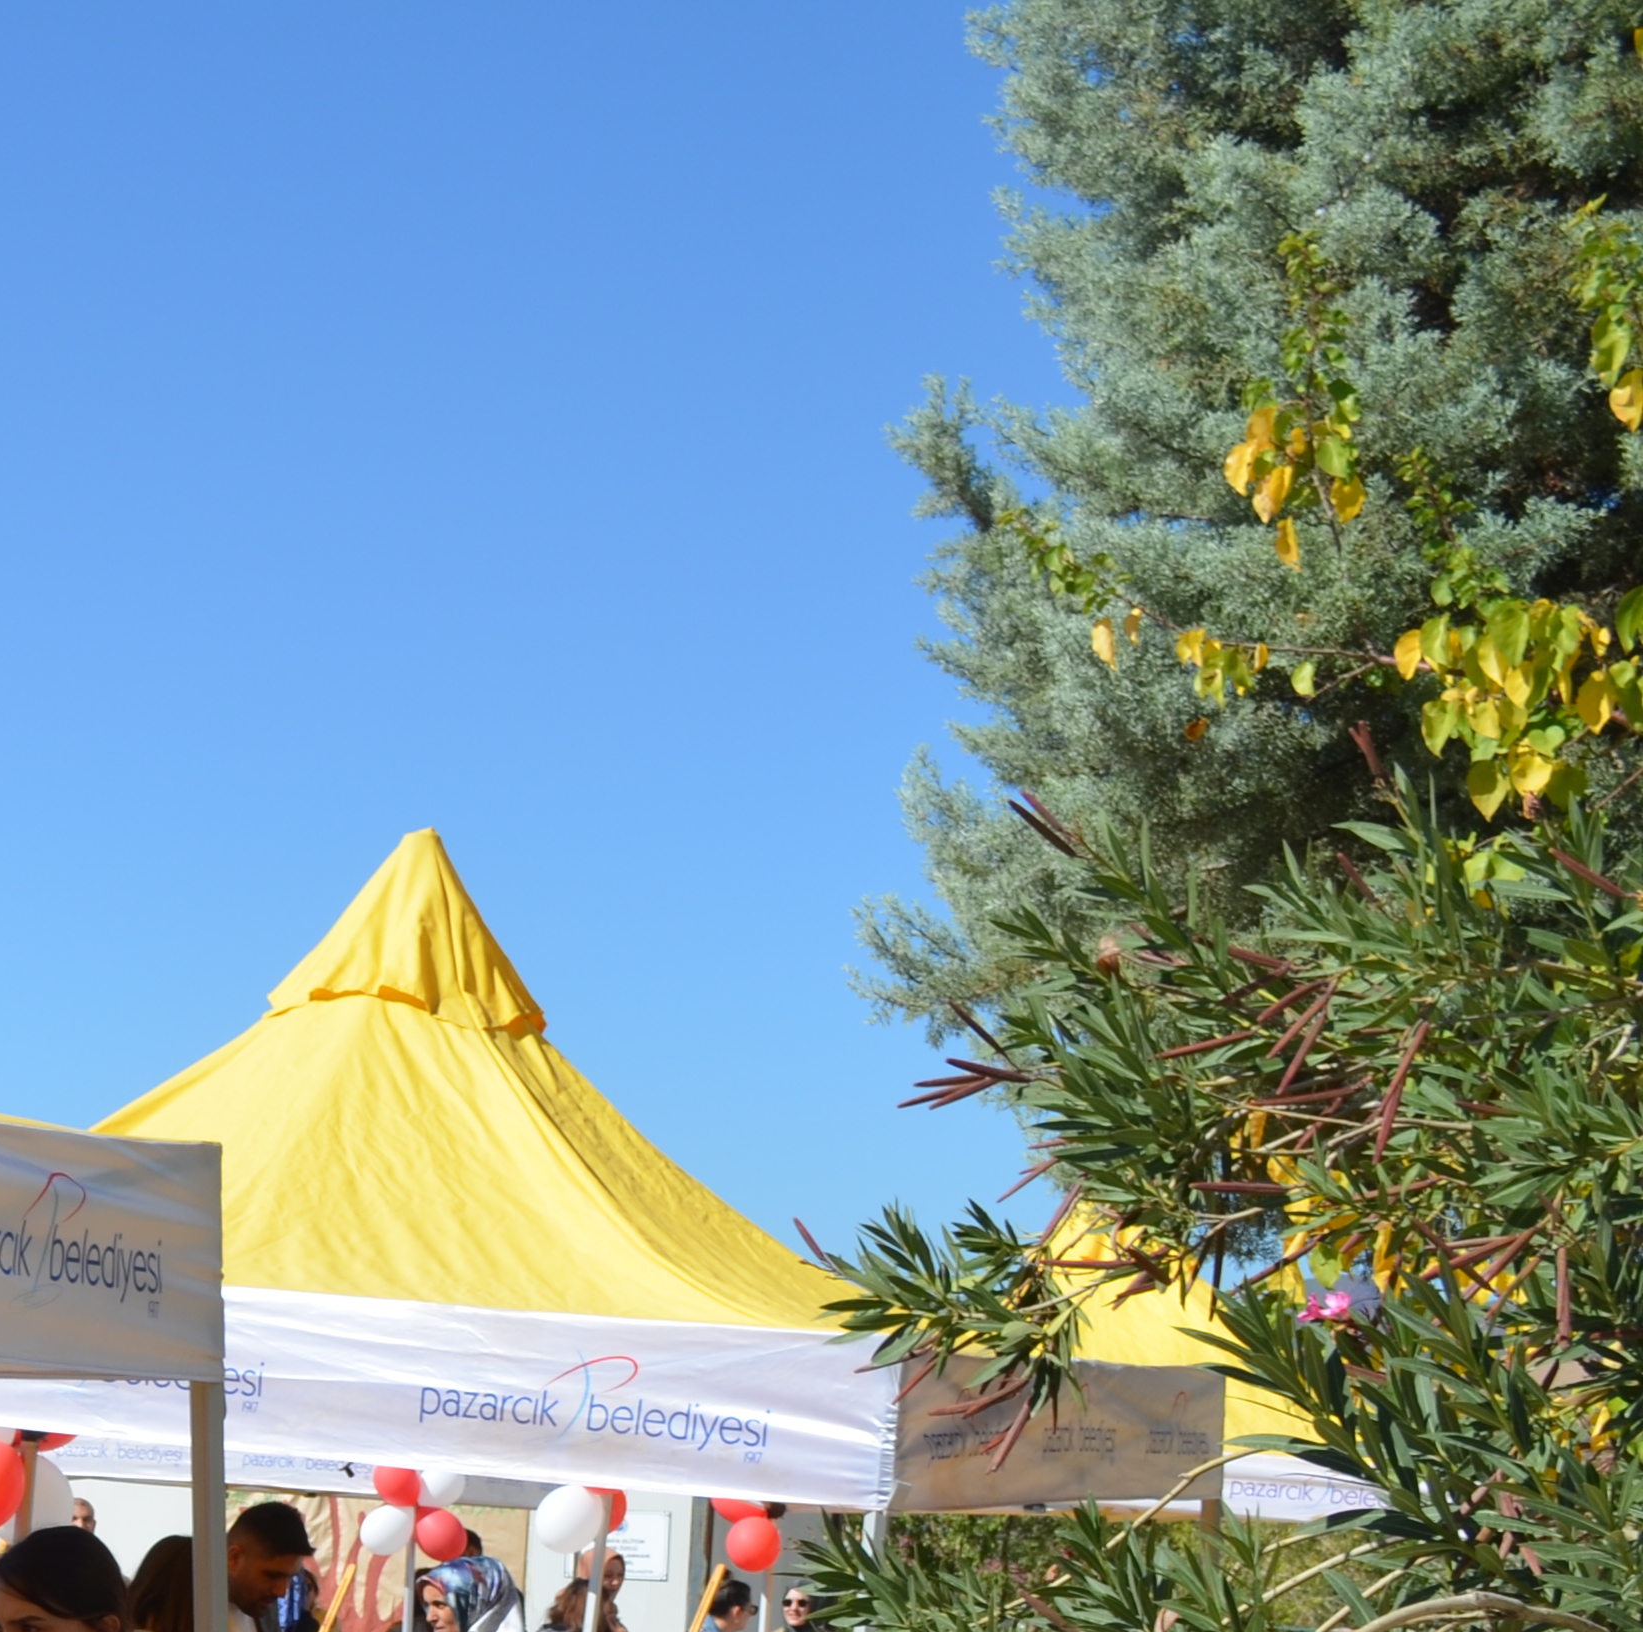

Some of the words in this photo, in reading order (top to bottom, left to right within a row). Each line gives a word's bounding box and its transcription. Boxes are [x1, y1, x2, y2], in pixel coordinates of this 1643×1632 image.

[49, 1224, 162, 1302] belediyesi
[419, 1386, 559, 1428] pazarcık
[587, 1394, 772, 1452] belediyesi
[1229, 1479, 1314, 1501] pazarcık
